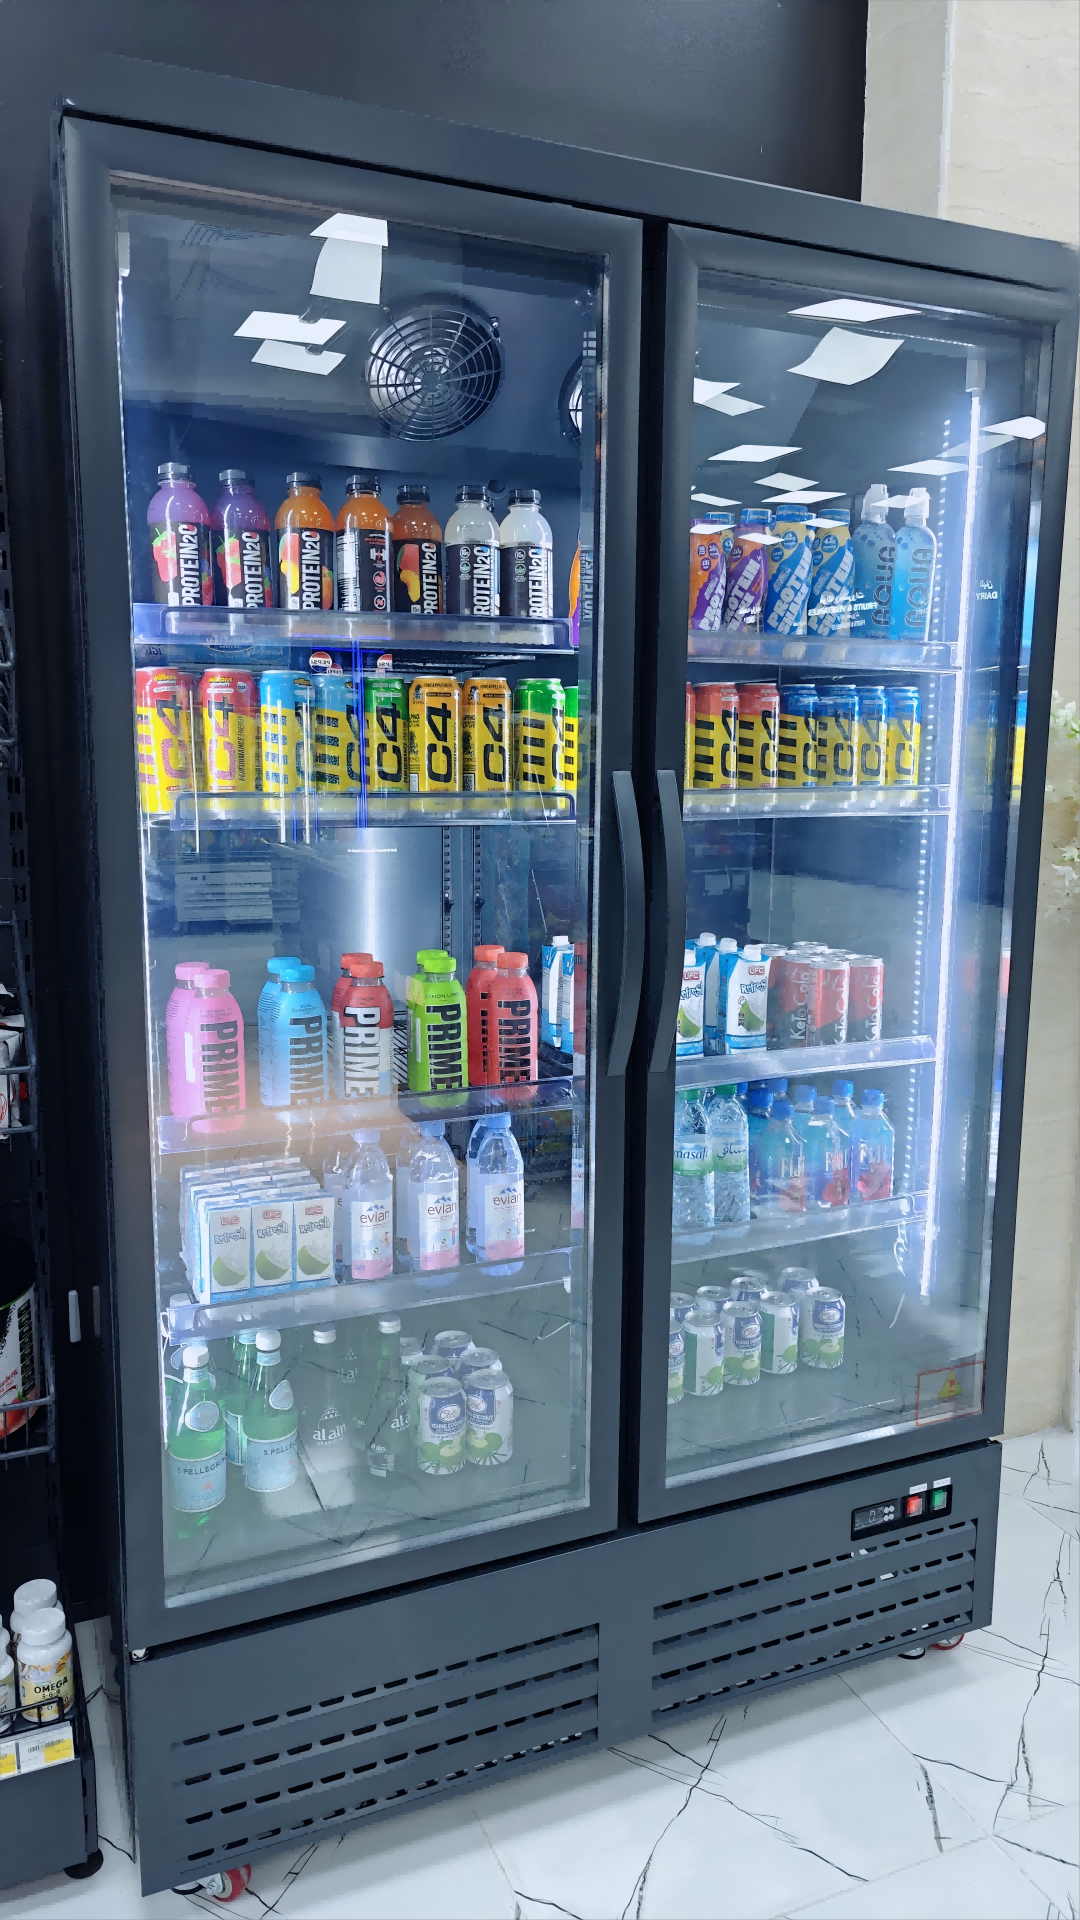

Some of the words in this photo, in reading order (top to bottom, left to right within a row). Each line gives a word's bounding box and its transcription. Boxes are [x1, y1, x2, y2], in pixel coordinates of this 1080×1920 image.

[376, 702, 403, 783] C4
[426, 702, 453, 783] C4
[482, 704, 507, 783] C4
[684, 972, 699, 980] UFC
[749, 967, 765, 975] UFC
[426, 1003, 463, 1090] PRIME
[498, 1000, 532, 1082] PRIME
[289, 1014, 324, 1106] PRIME
[343, 1006, 381, 1098] PRIME
[200, 1019, 240, 1115] PRIME
[264, 1211, 281, 1220] UFC
[306, 1206, 323, 1215] UFC
[359, 1209, 390, 1224] evian
[427, 1201, 457, 1216] evian
[256, 1221, 289, 1239] Refresh
[299, 1216, 331, 1234] Refresh
[34, 1676, 68, 1694] OMEGA
